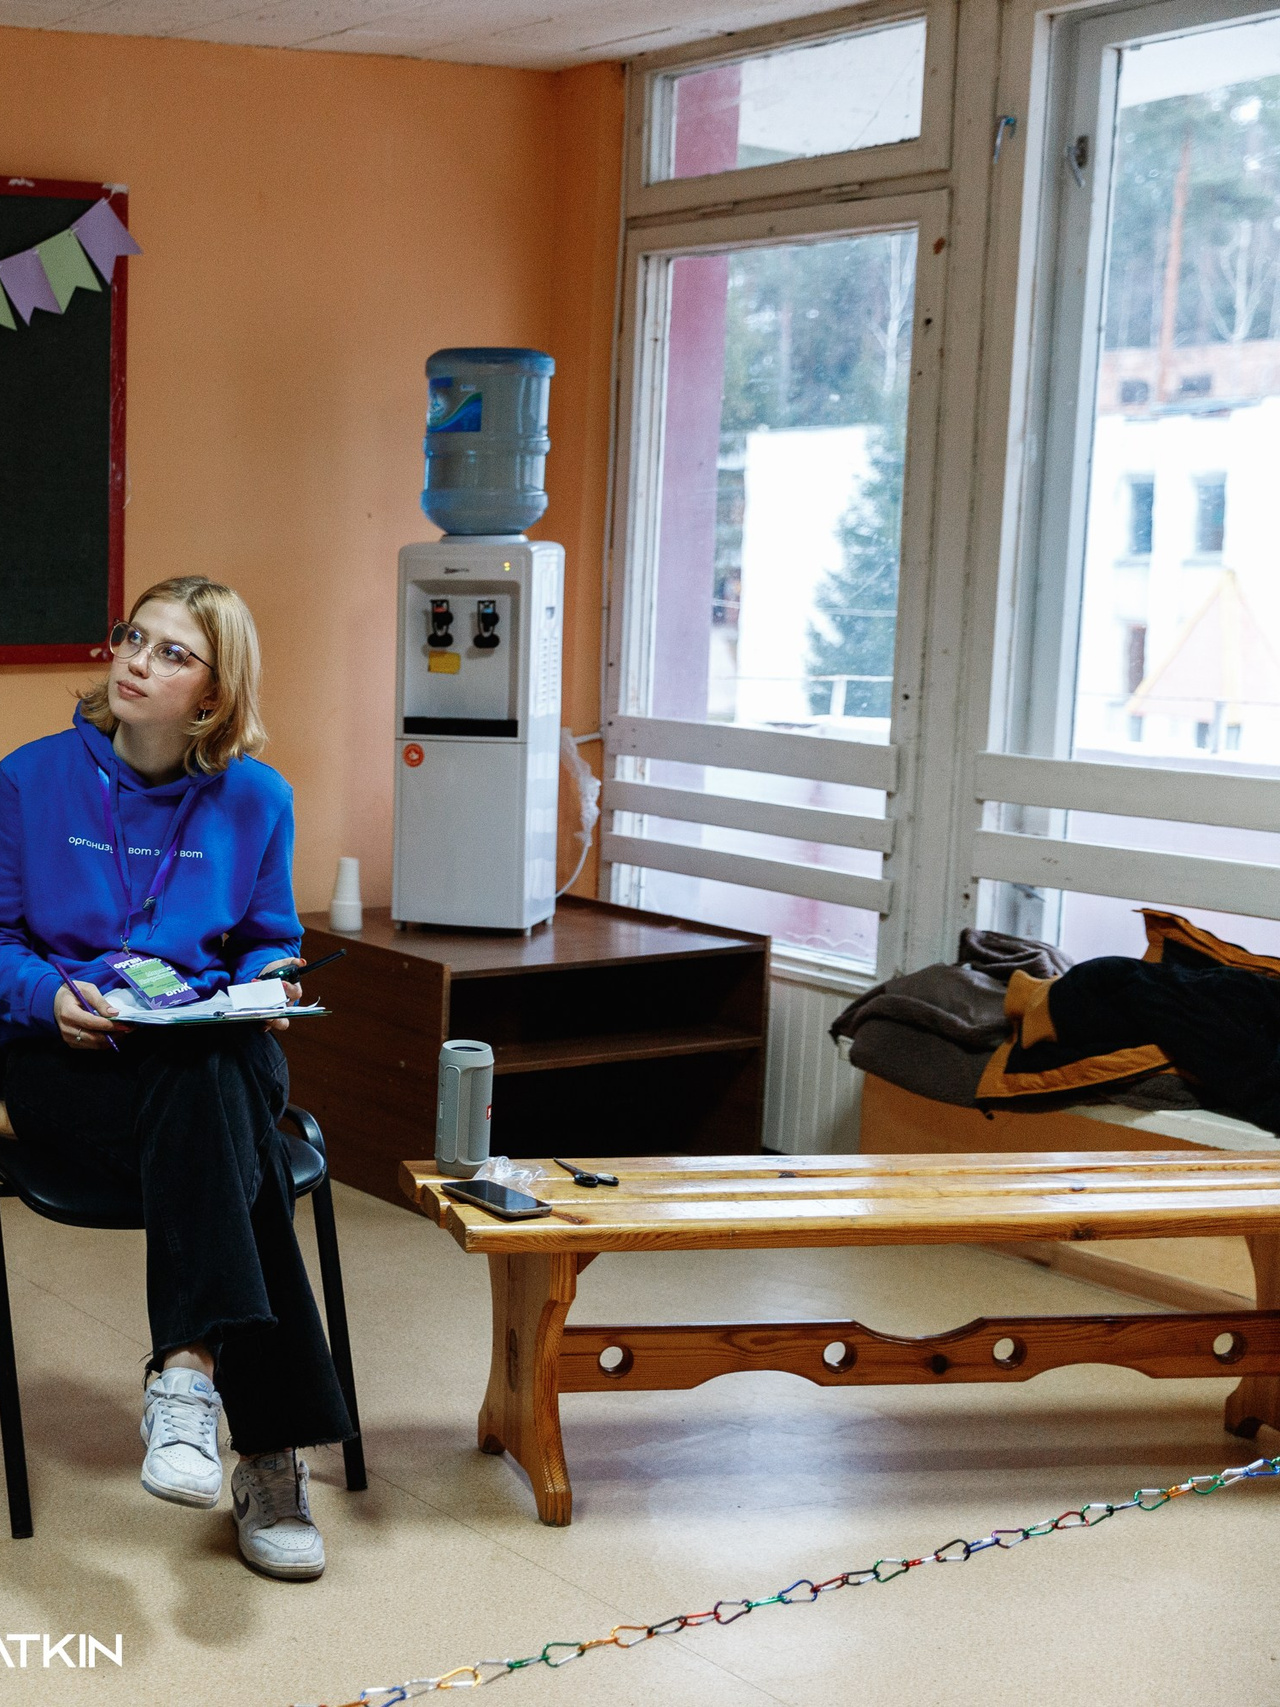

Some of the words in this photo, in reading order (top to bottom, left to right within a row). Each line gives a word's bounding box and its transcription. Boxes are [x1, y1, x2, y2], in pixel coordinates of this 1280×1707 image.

[68, 836, 113, 853] организу
[128, 847, 152, 856] вот
[180, 850, 203, 858] вот
